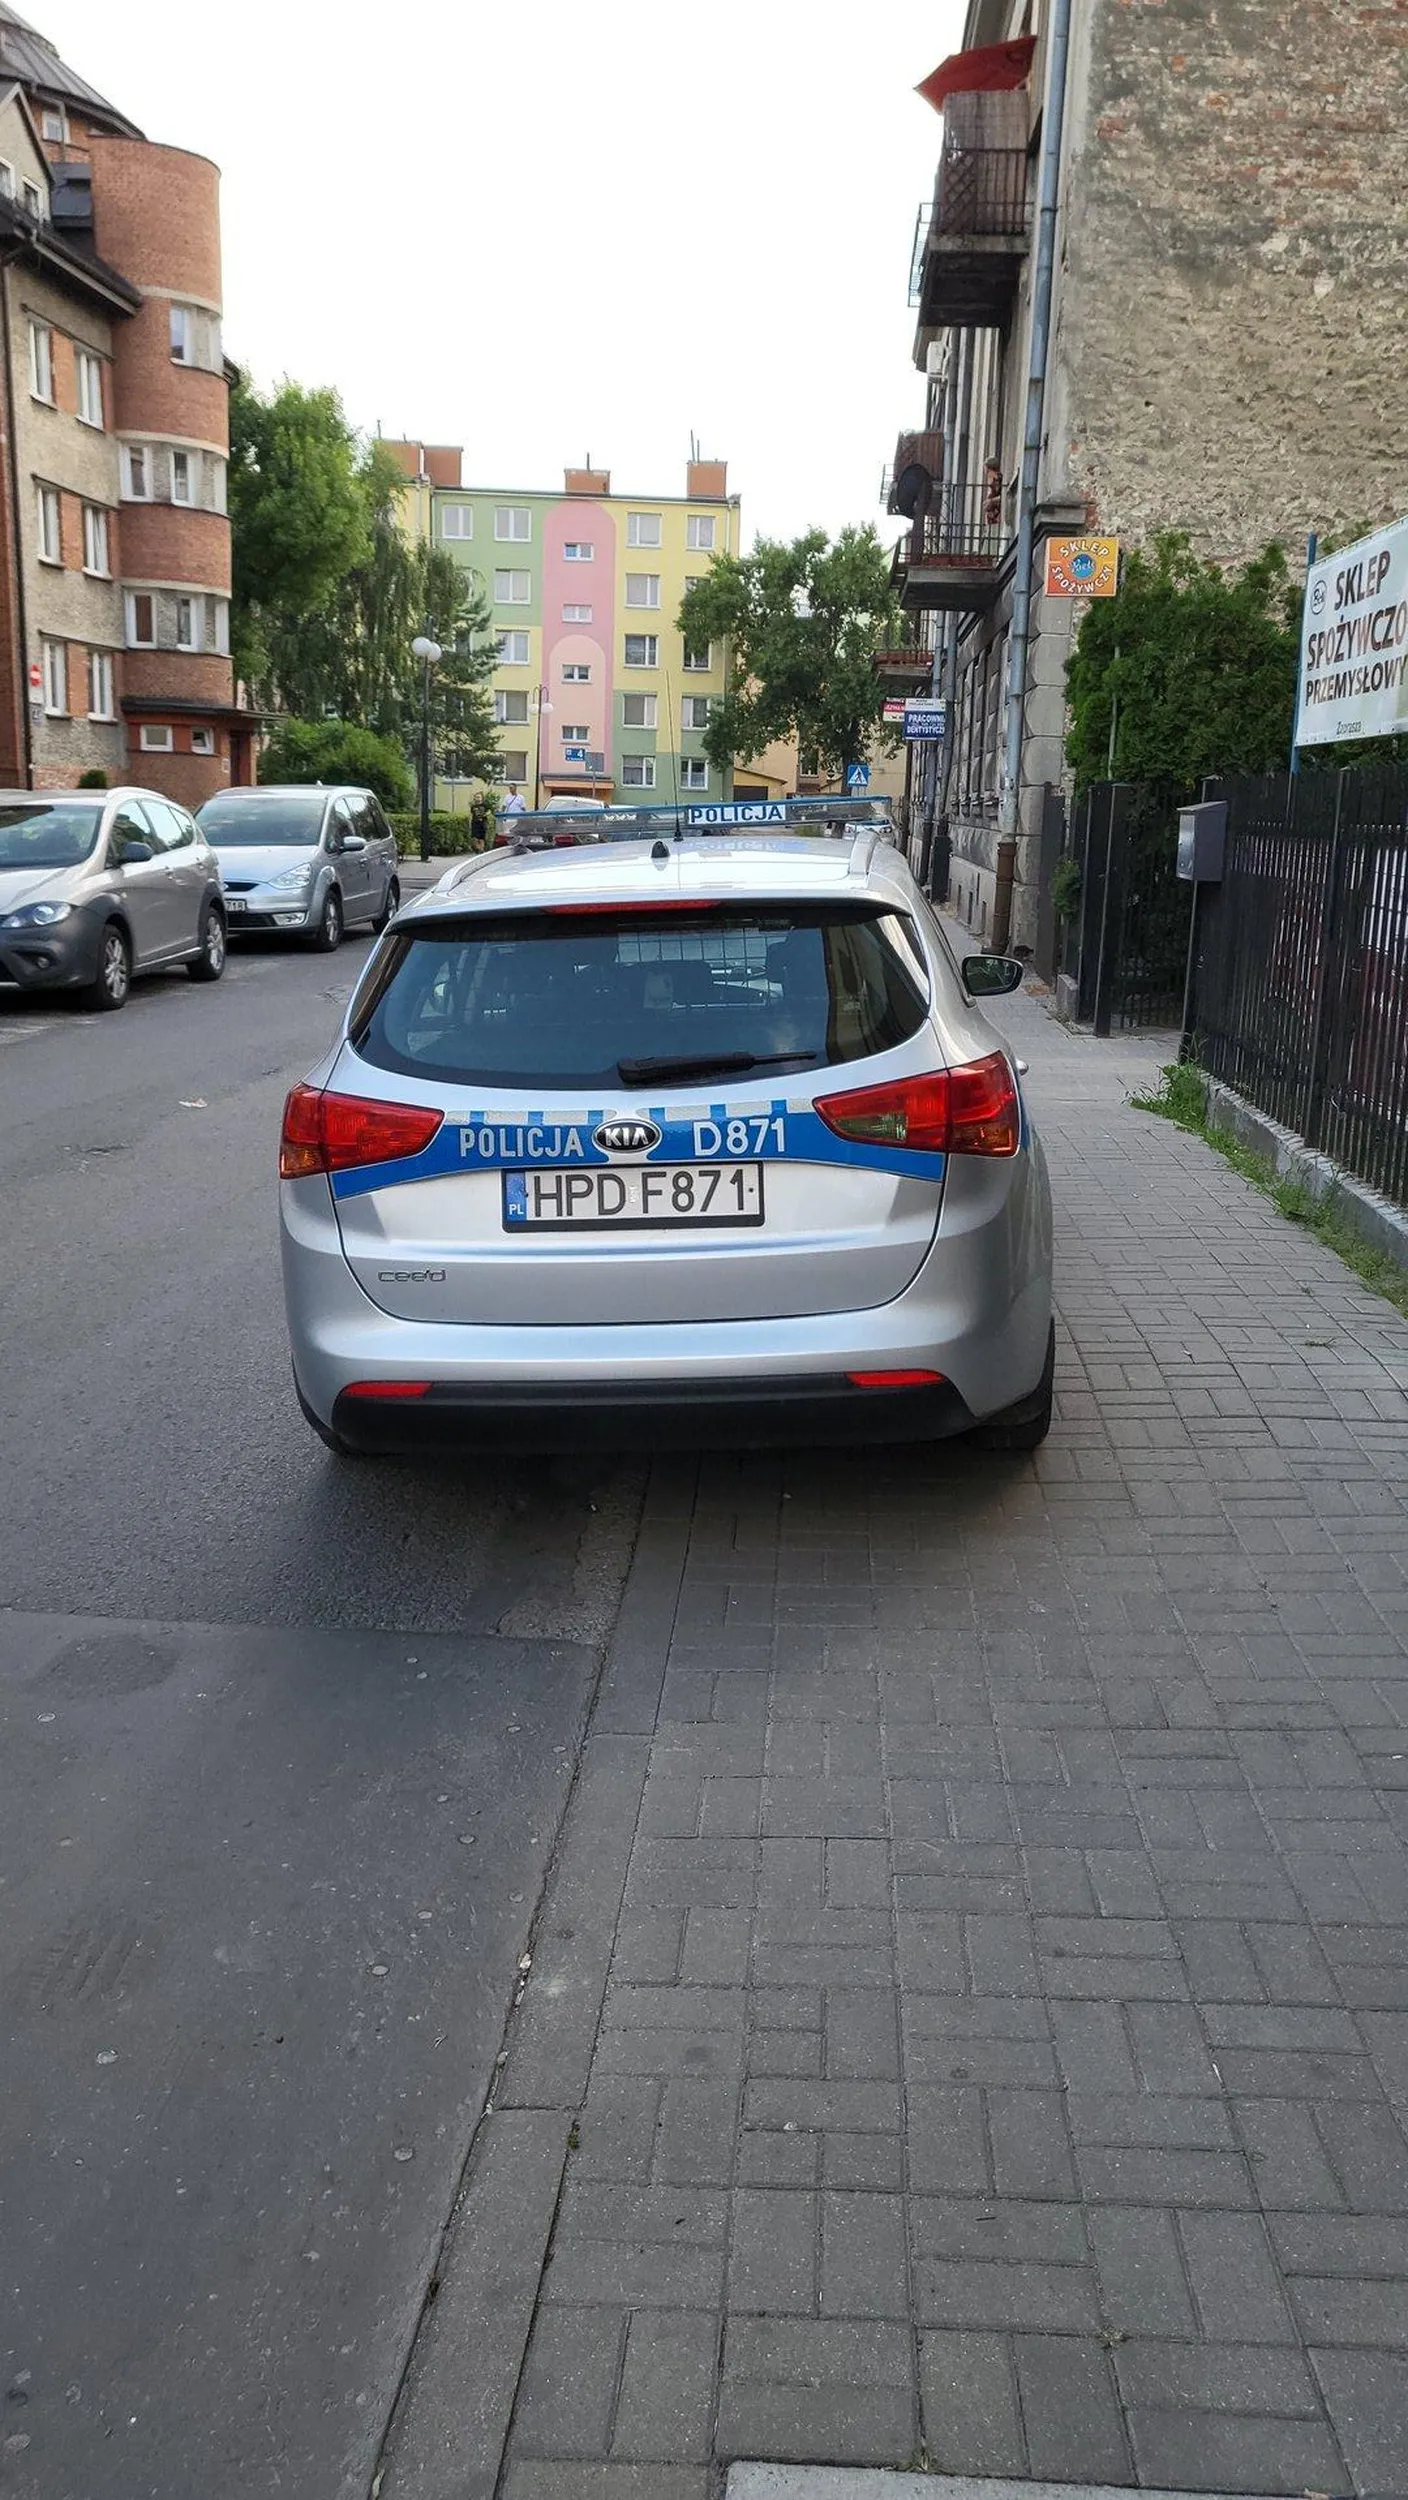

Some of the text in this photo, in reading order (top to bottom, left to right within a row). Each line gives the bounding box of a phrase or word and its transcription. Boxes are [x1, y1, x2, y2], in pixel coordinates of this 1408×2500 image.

[1060, 540, 1109, 557] SKLEP
[1334, 550, 1391, 611] SKLEP
[1305, 654, 1408, 707] PRZEMYSŁOWY
[691, 805, 783, 824] POLICJA
[459, 1127, 584, 1158] POLICJA
[604, 1126, 649, 1147] KIA
[693, 1117, 785, 1156] D871
[533, 1168, 744, 1217] HPD F871
[509, 1203, 524, 1215] PL
